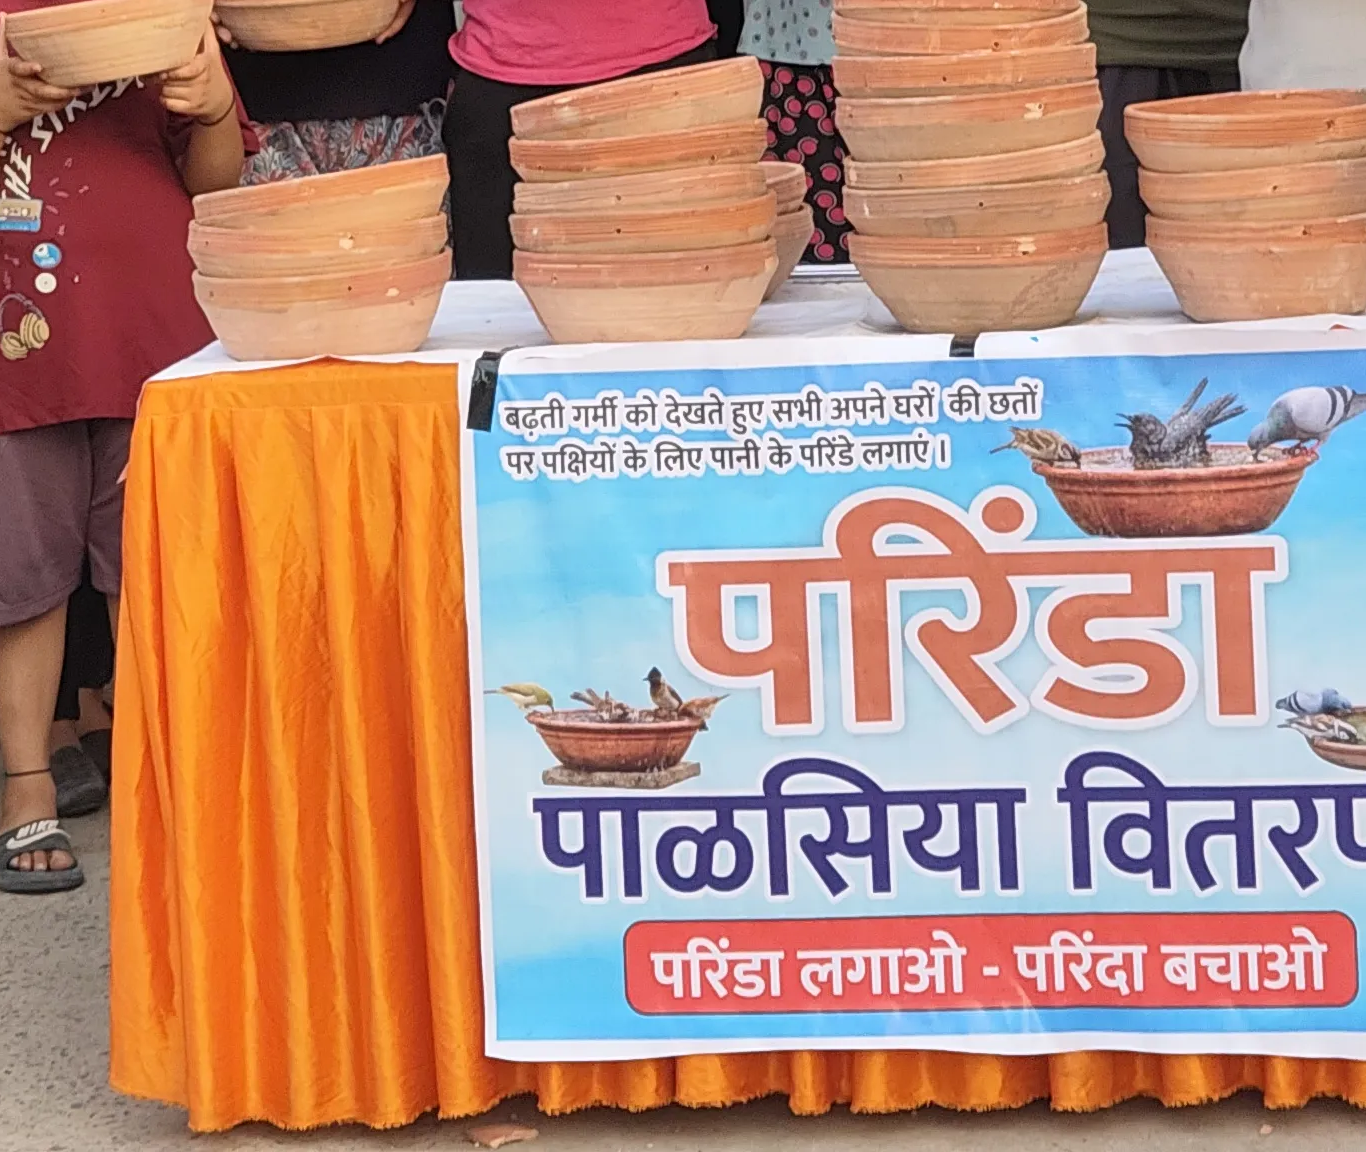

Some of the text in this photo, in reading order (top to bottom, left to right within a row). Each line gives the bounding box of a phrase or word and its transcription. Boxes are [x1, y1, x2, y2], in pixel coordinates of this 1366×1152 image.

[503, 381, 1040, 438] बढ़ती गर्मी को देखते हुए सभी अपने घरों की छतों
[506, 451, 536, 475] पर
[542, 440, 618, 475] पक्षियों
[622, 444, 649, 472] के
[655, 441, 703, 473] लिए
[710, 438, 762, 471] पानी
[767, 440, 794, 470] के
[861, 433, 930, 467] लगाएं
[667, 495, 1275, 726] परिंडा
[532, 758, 1027, 899] पाळसिया
[796, 930, 967, 997] लगाओ
[1160, 927, 1327, 993] बचाओ
